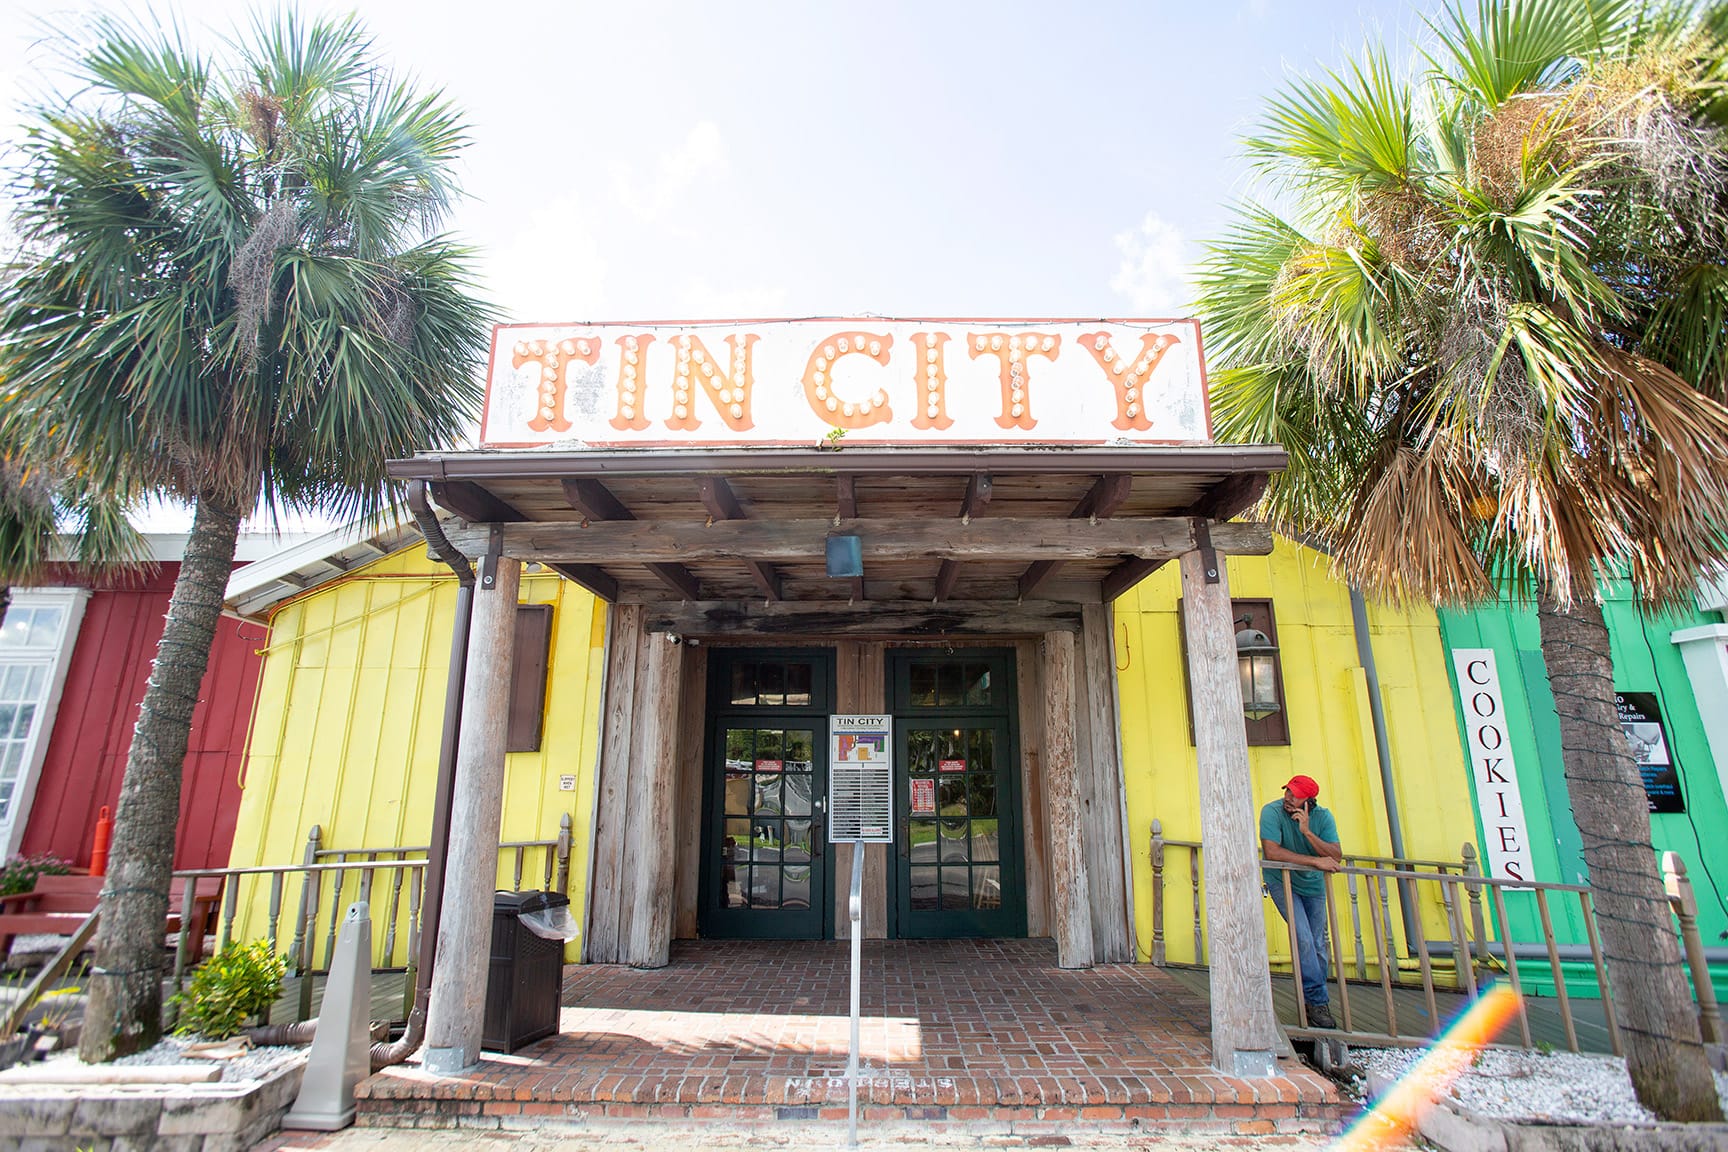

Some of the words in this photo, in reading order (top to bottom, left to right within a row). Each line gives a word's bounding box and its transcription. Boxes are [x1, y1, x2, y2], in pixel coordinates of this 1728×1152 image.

[512, 332, 761, 432] TIN
[800, 331, 1183, 432] CITY
[1618, 712, 1646, 721] Repairs
[1467, 660, 1525, 888] COOKIES
